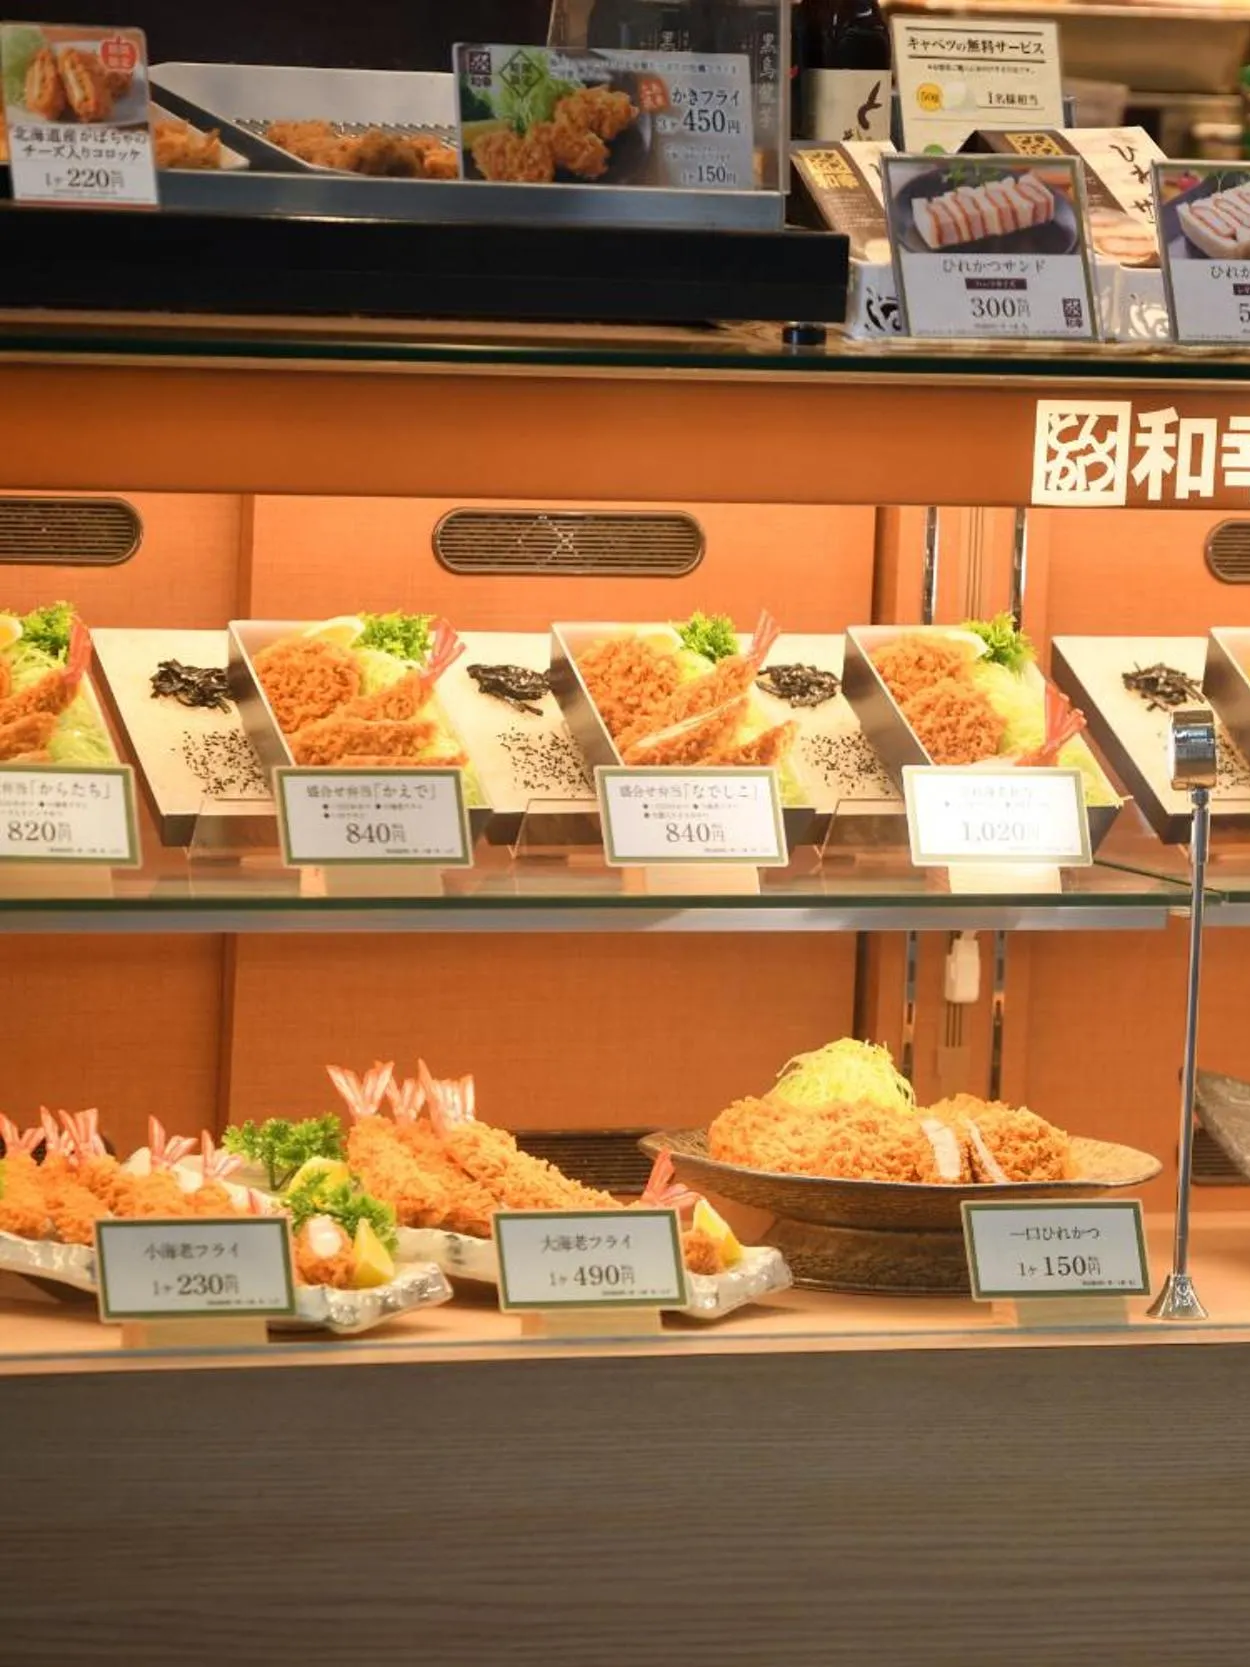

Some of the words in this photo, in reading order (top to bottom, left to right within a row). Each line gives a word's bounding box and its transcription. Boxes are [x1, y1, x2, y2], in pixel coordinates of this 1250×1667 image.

[907, 36, 1045, 54] キャベツの無料サービス
[671, 87, 741, 107] かきフライ
[683, 109, 741, 134] 450円
[23, 144, 142, 161] チーズ入りコロッケ
[942, 259, 1046, 273] ひれかつサンド
[665, 822, 725, 843] 840円
[541, 1232, 632, 1253] 大海老フライ
[1009, 1226, 1100, 1241] 一口ひれかつ
[145, 1242, 239, 1260] 小海老フライ
